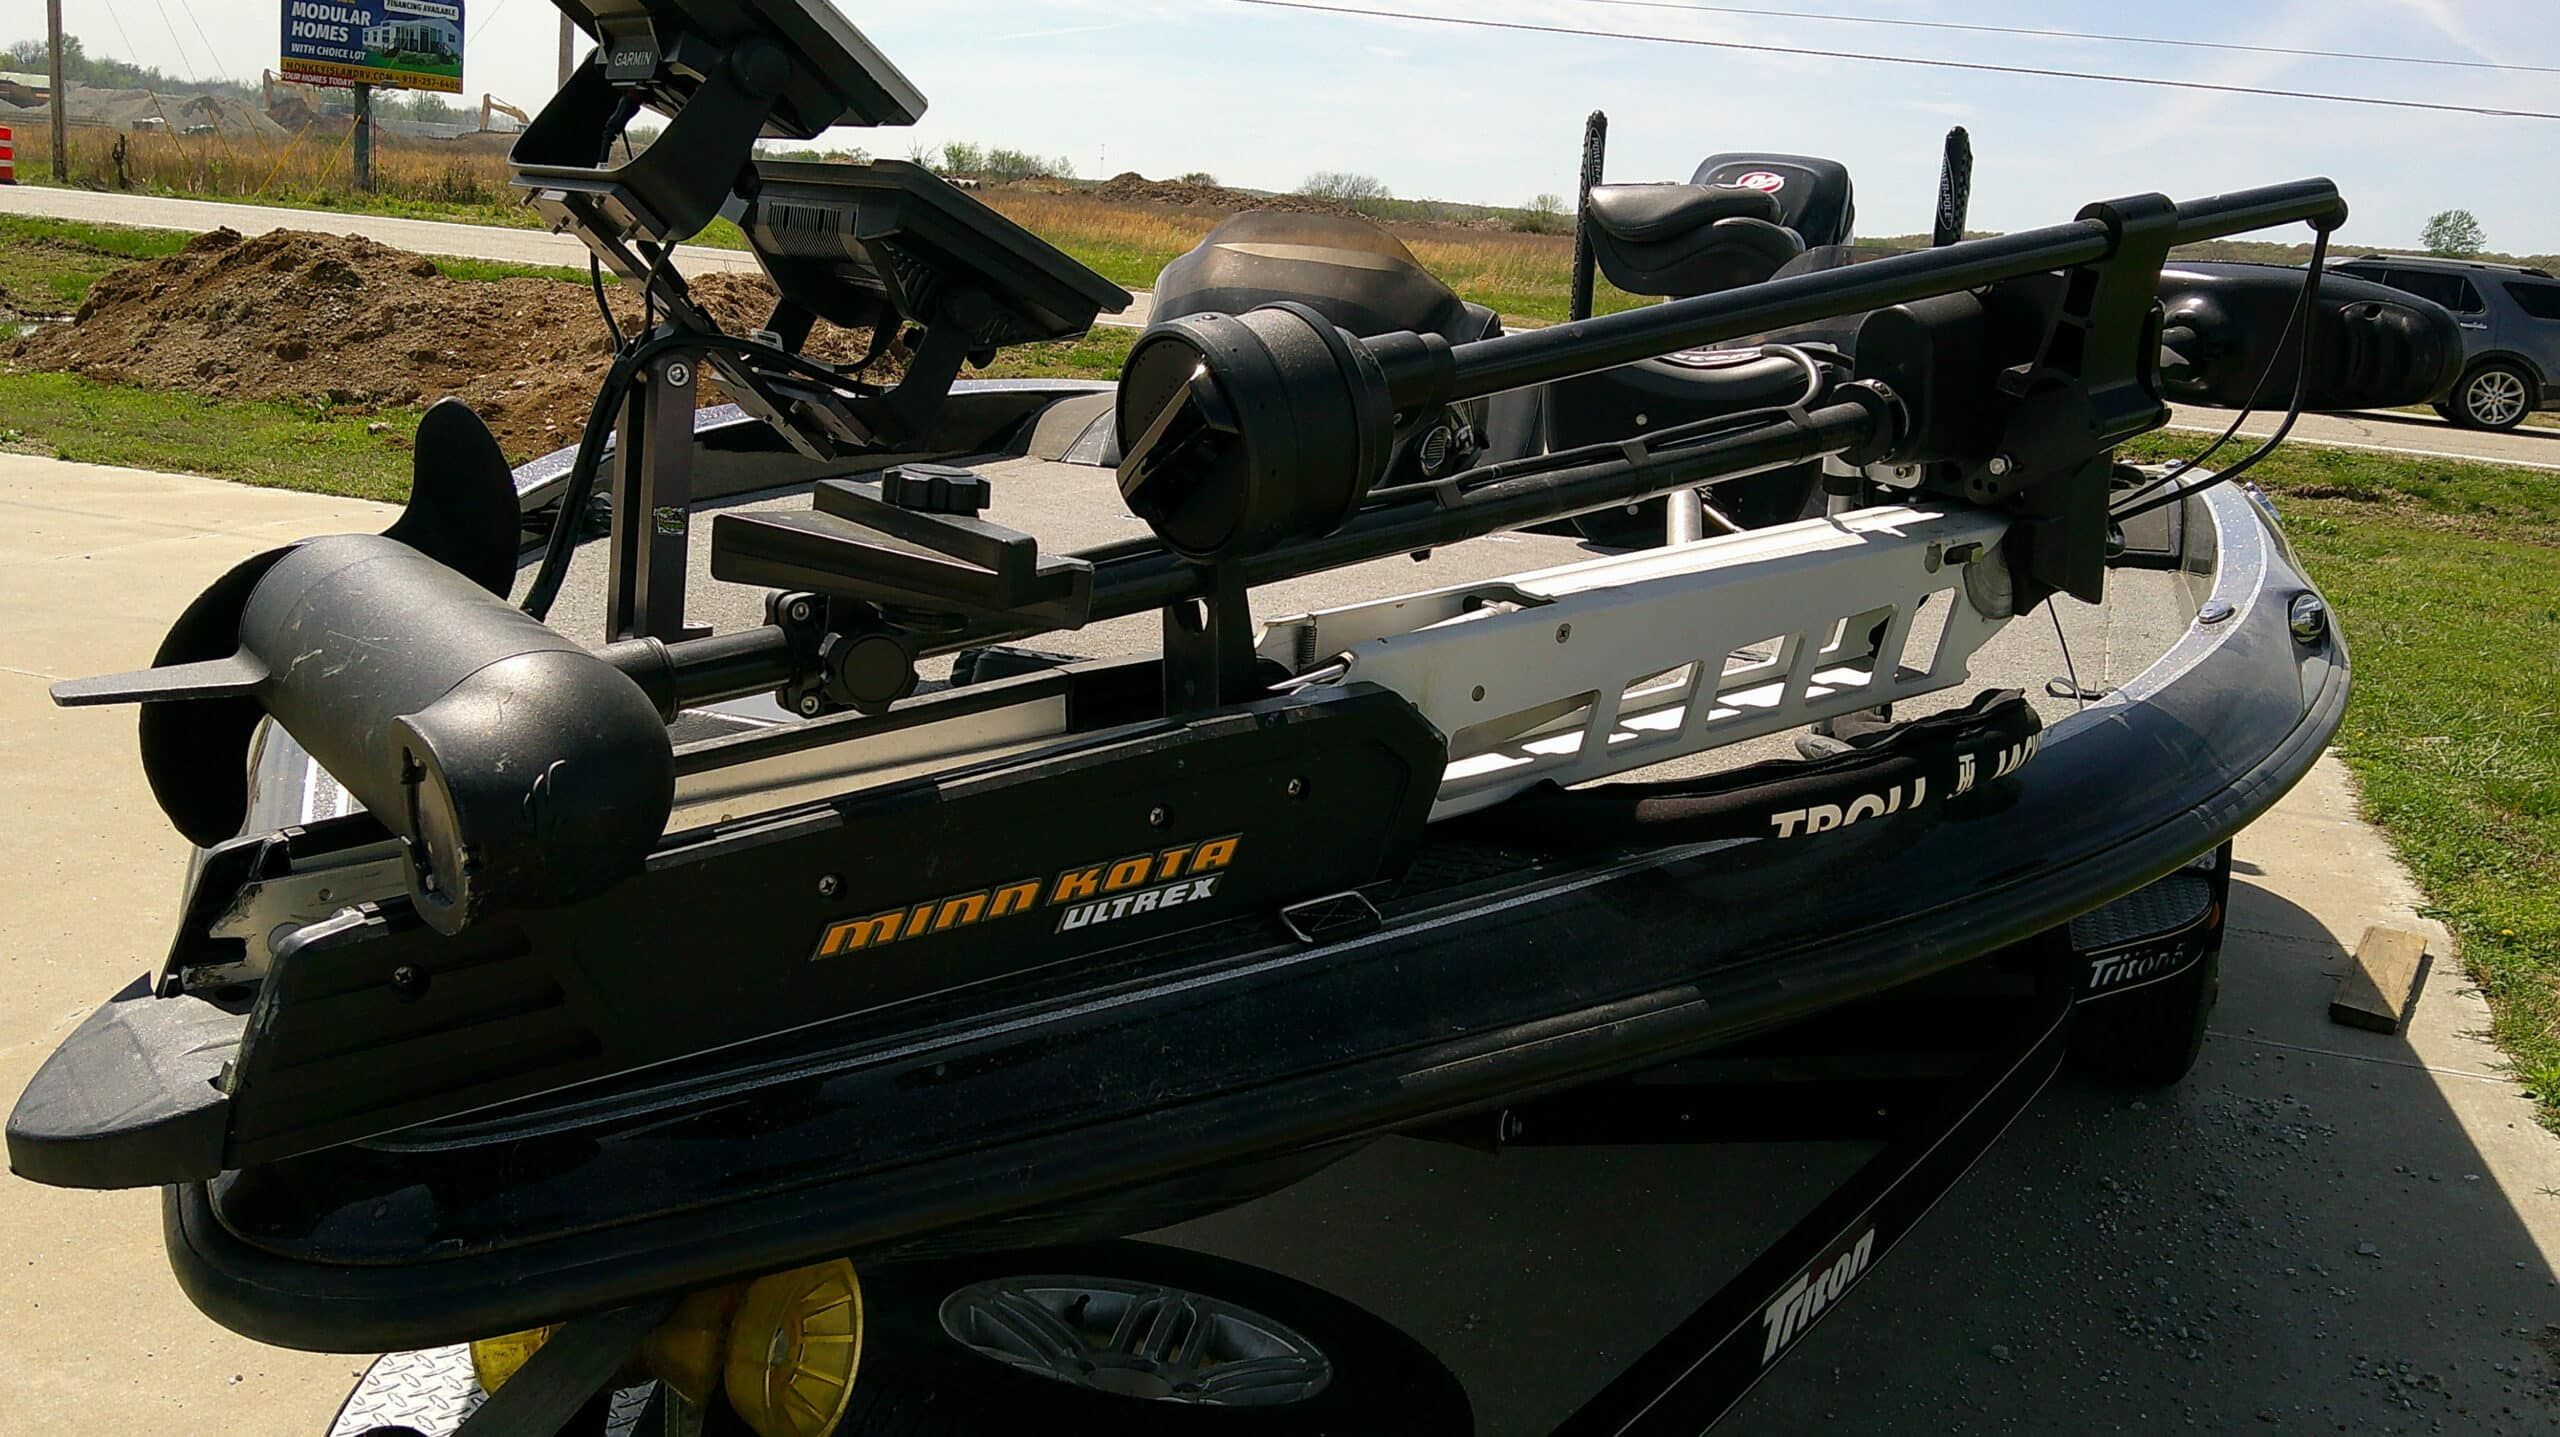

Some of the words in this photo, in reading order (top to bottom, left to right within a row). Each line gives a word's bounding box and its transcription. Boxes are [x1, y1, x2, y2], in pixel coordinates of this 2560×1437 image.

[291, 1, 372, 27] MODULAR
[386, 0, 422, 11] FINANCING
[423, 4, 456, 17] AVAILABLE
[291, 20, 349, 42] HOMES
[291, 42, 315, 55] WITH
[316, 46, 348, 59] CHOICE
[349, 50, 367, 61] LOT
[614, 51, 652, 66] GARMIN
[815, 879, 1041, 958] MINN
[1049, 834, 1242, 905] KOTA
[1061, 876, 1219, 932] ULTREX
[1761, 1228, 1876, 1366] Triton
